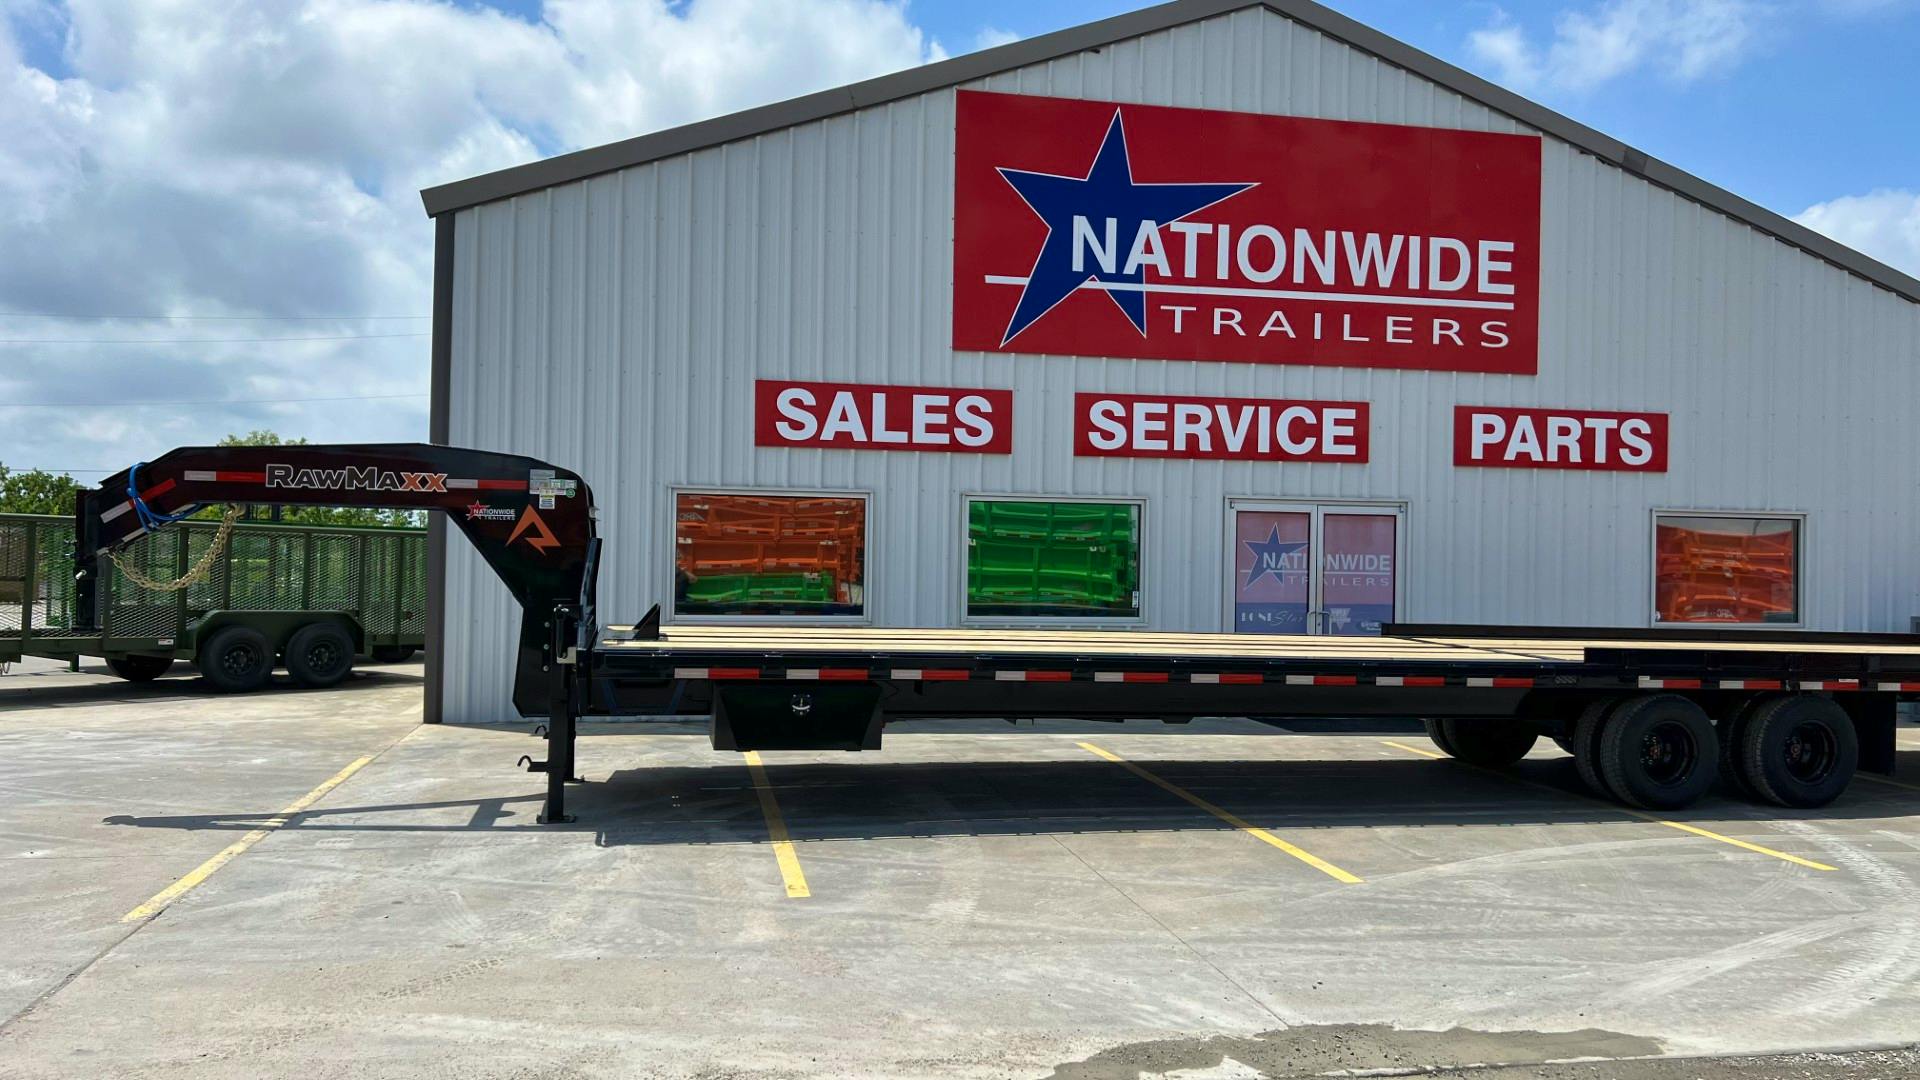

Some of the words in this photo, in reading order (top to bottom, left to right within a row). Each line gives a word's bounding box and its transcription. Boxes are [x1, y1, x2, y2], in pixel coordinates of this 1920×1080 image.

[1072, 215, 1515, 295] NATIONWIDE
[1160, 306, 1510, 349] TRAILERS
[775, 387, 994, 447] SALES
[1088, 399, 1357, 456] SERVICE
[1471, 413, 1653, 466] PARTS
[1262, 552, 1391, 572] NATINWIDE
